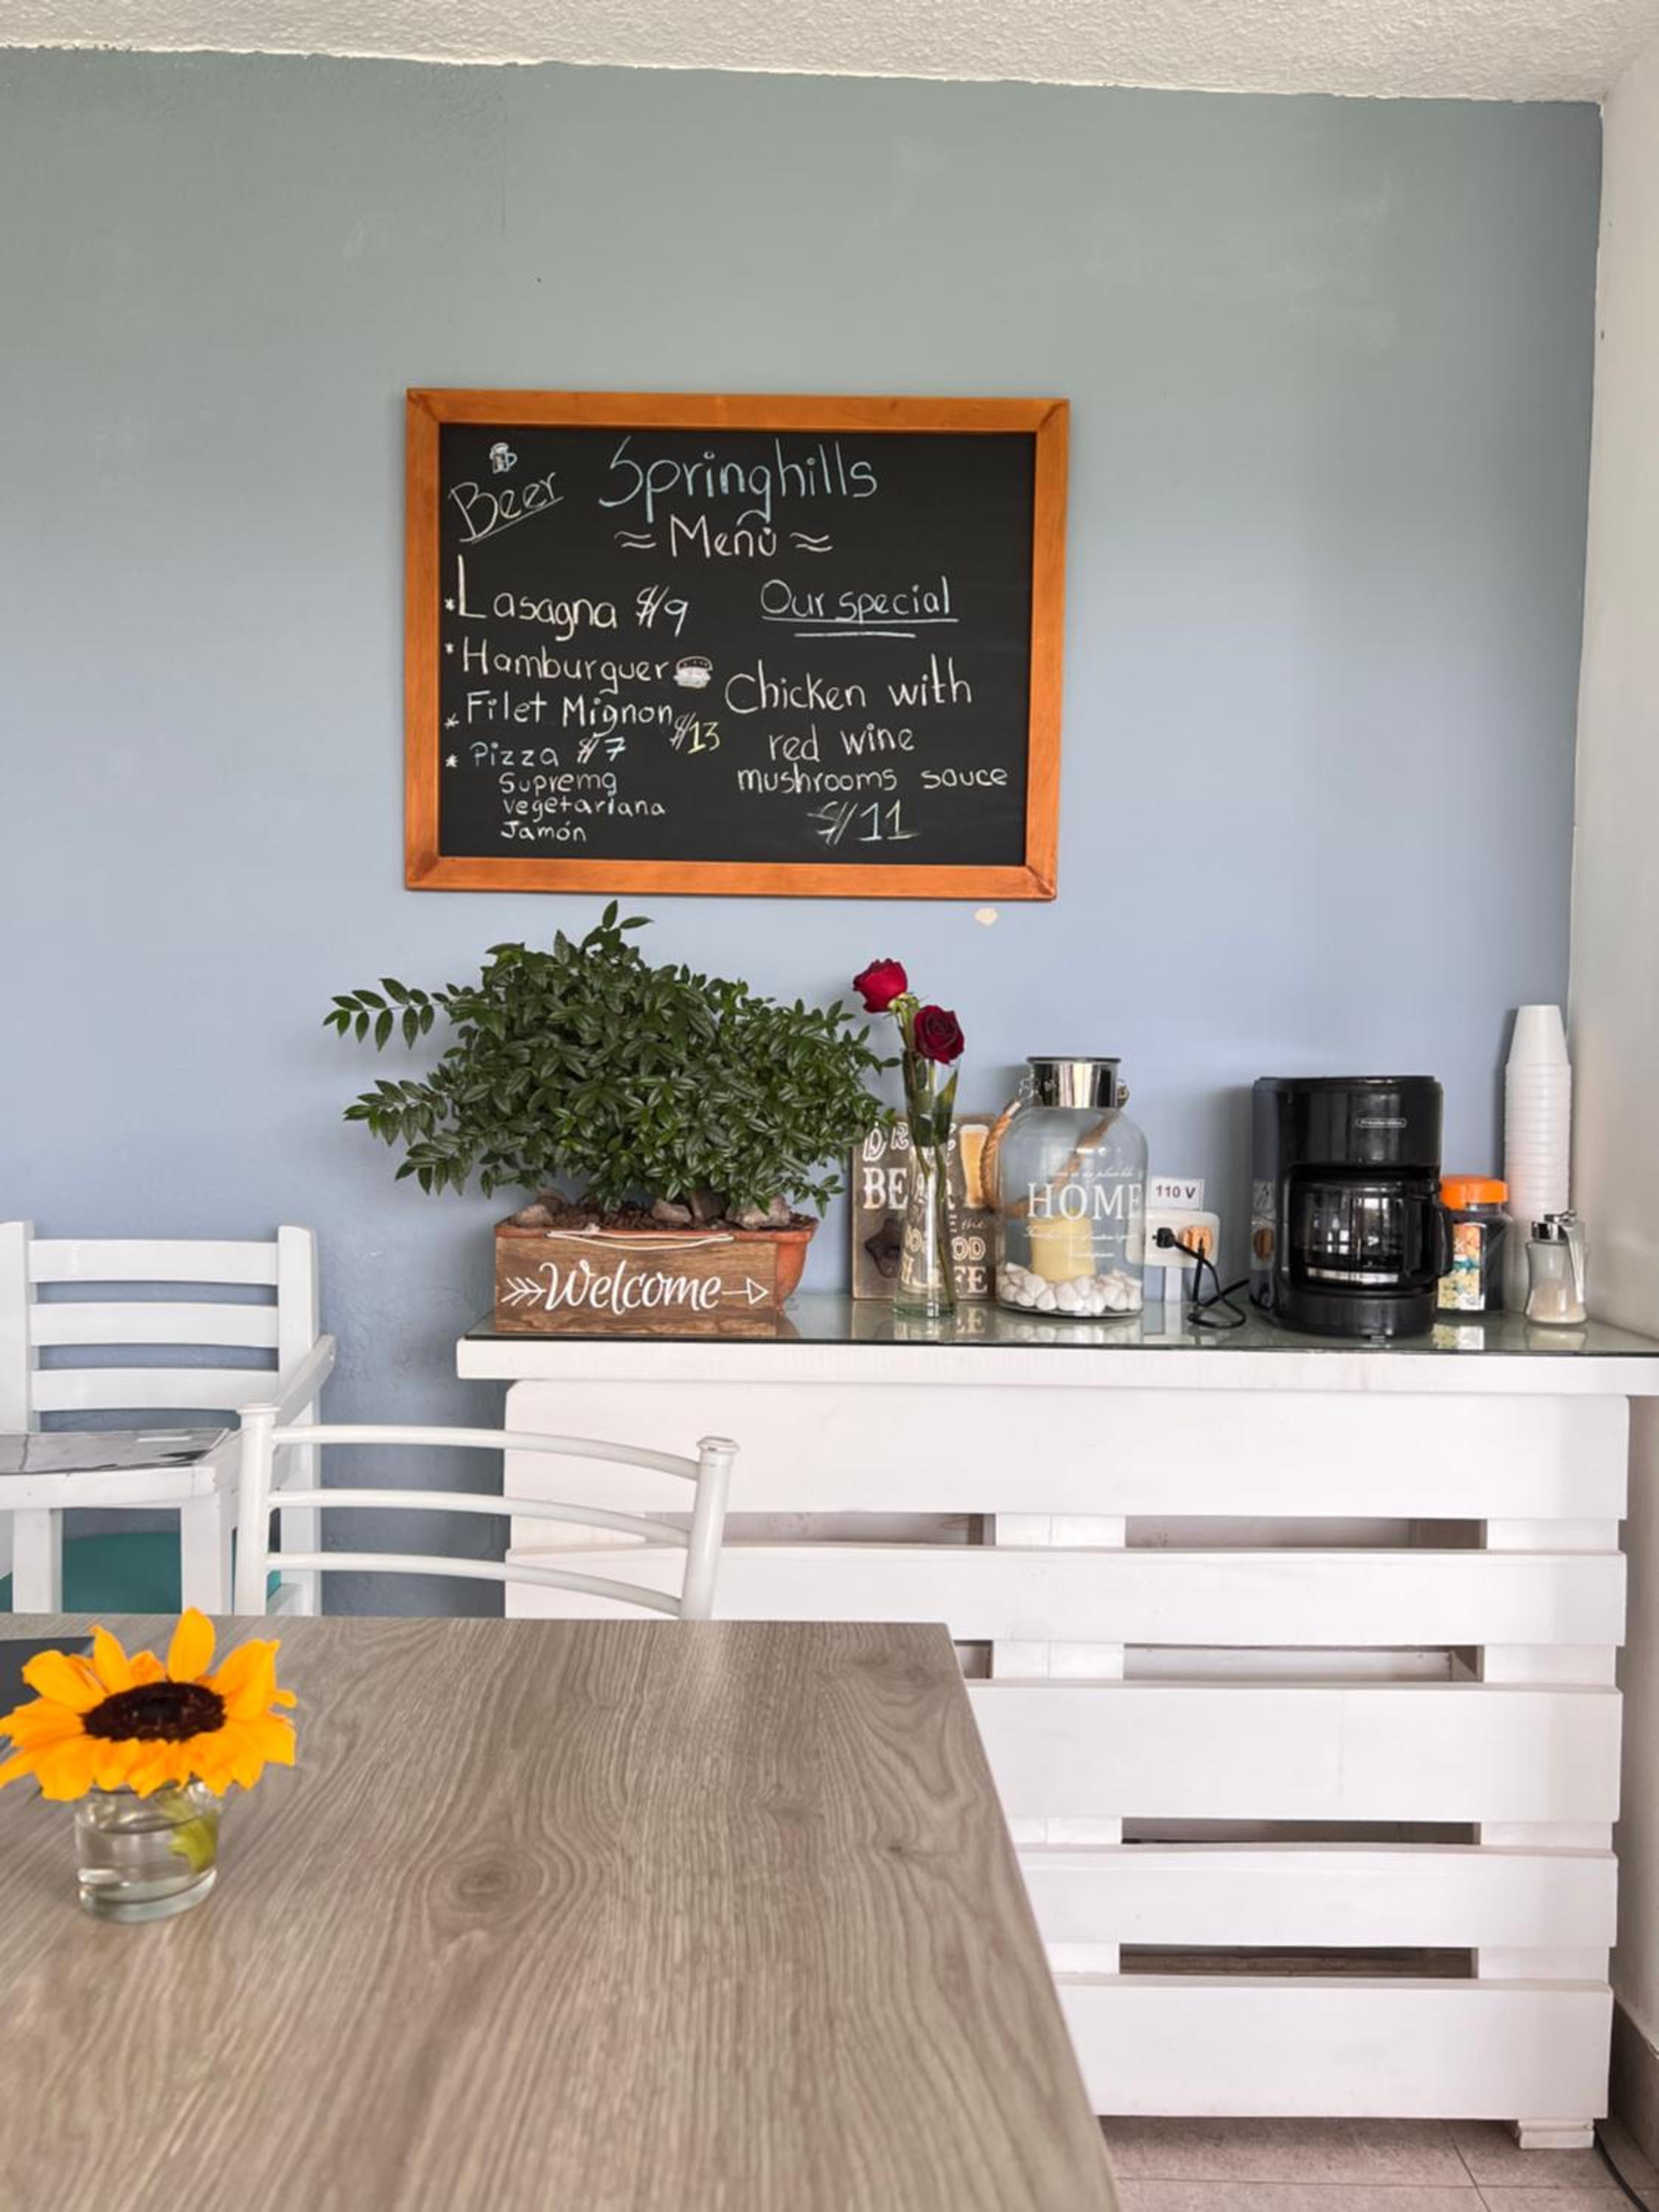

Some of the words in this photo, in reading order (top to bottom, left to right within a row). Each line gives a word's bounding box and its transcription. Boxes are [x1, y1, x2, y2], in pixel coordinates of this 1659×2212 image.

[599, 437, 877, 525] Springhills
[448, 471, 557, 543] Beer
[457, 554, 618, 641] Lasagna
[760, 579, 824, 618] Our
[835, 575, 950, 624] special
[462, 636, 669, 695] Hamburguer
[725, 658, 866, 714] Chicken
[888, 653, 973, 707] with
[466, 690, 547, 724] Filet
[562, 695, 673, 738] Mignon
[469, 741, 559, 768] Pizza
[768, 723, 821, 762] red
[839, 723, 916, 757] wine
[737, 762, 897, 794] mushrooms
[920, 766, 1009, 790] sauce
[500, 820, 586, 843] Jamón
[1026, 1181, 1142, 1220] HOME
[1155, 1185, 1180, 1197] 110
[1186, 1187, 1196, 1199] V
[539, 1259, 722, 1315] Welcome
